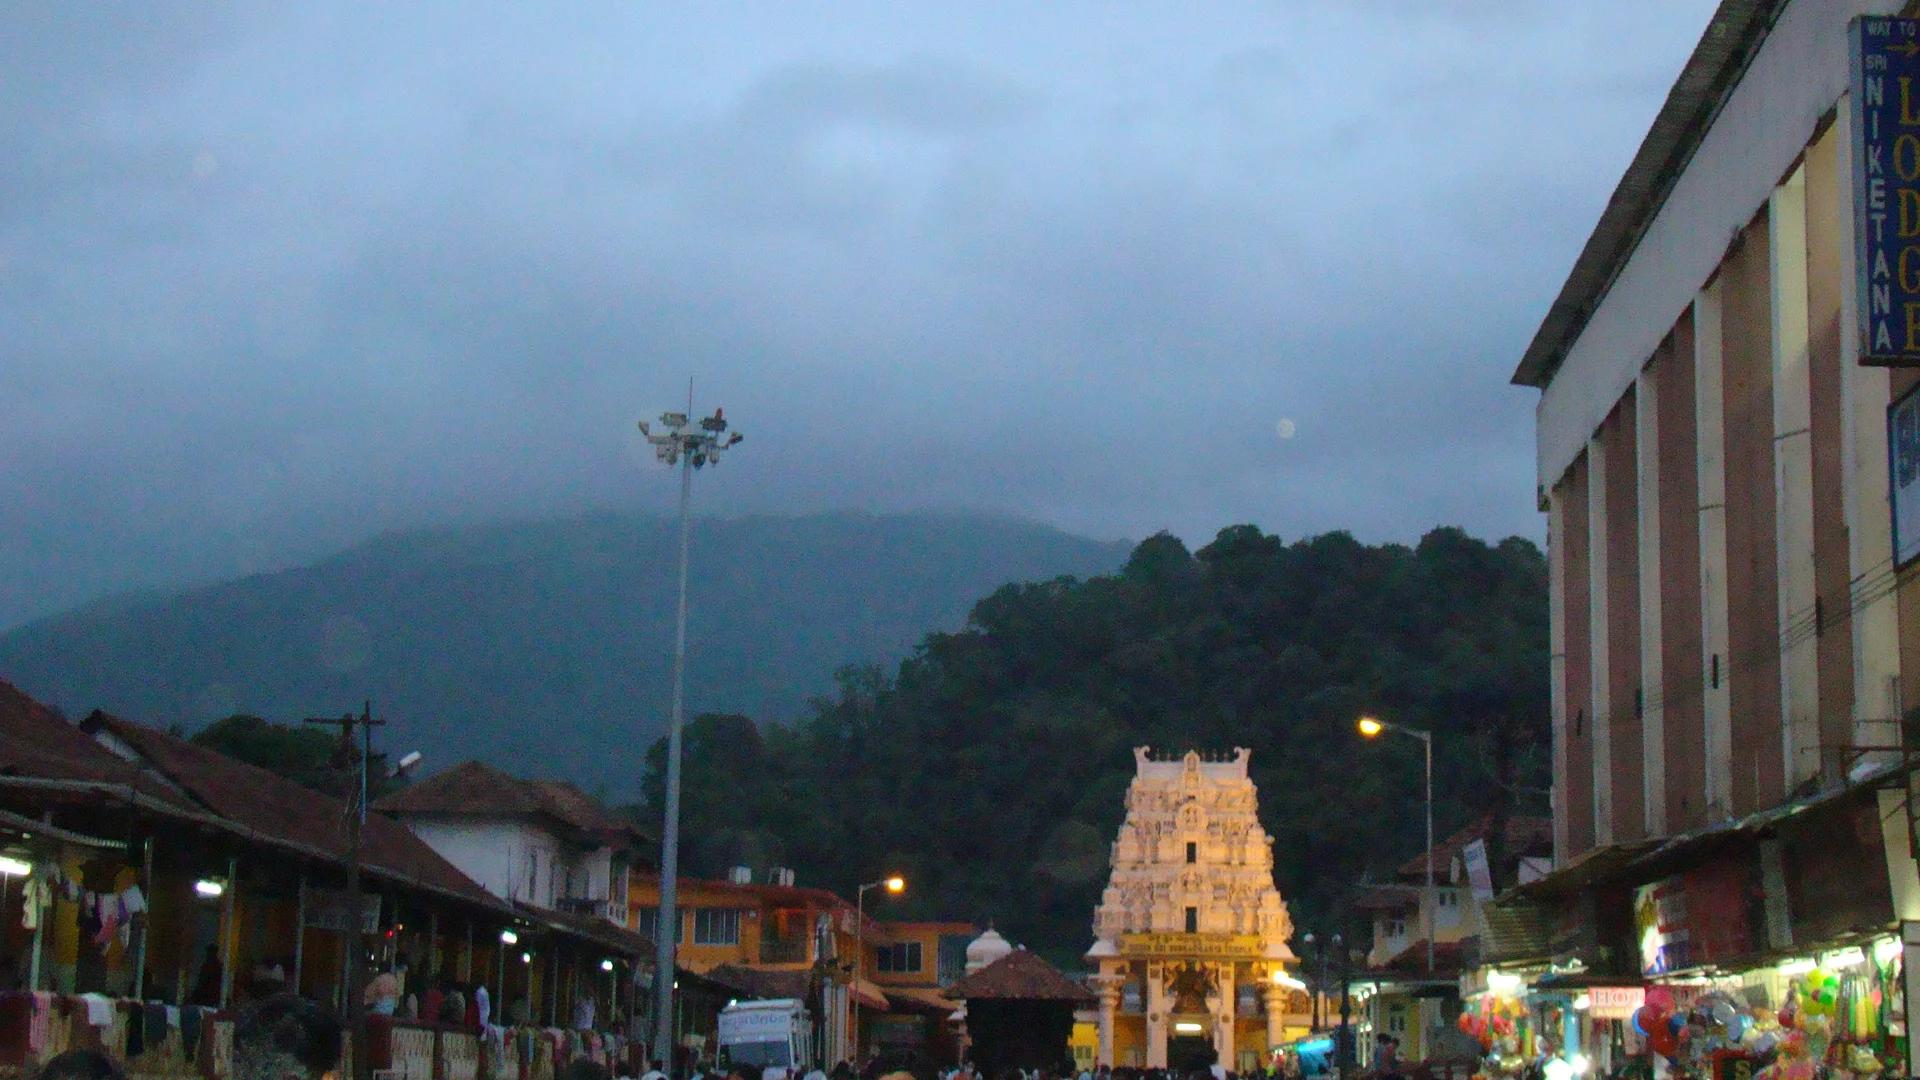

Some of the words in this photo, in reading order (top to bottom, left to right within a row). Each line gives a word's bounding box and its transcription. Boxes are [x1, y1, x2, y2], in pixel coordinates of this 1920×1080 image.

[1865, 54, 1887, 70] SRI
[1868, 21, 1891, 36] WAY
[1899, 21, 1916, 36] TO
[1866, 76, 1892, 351] NIKETANA
[1893, 75, 1920, 351] LODGE
